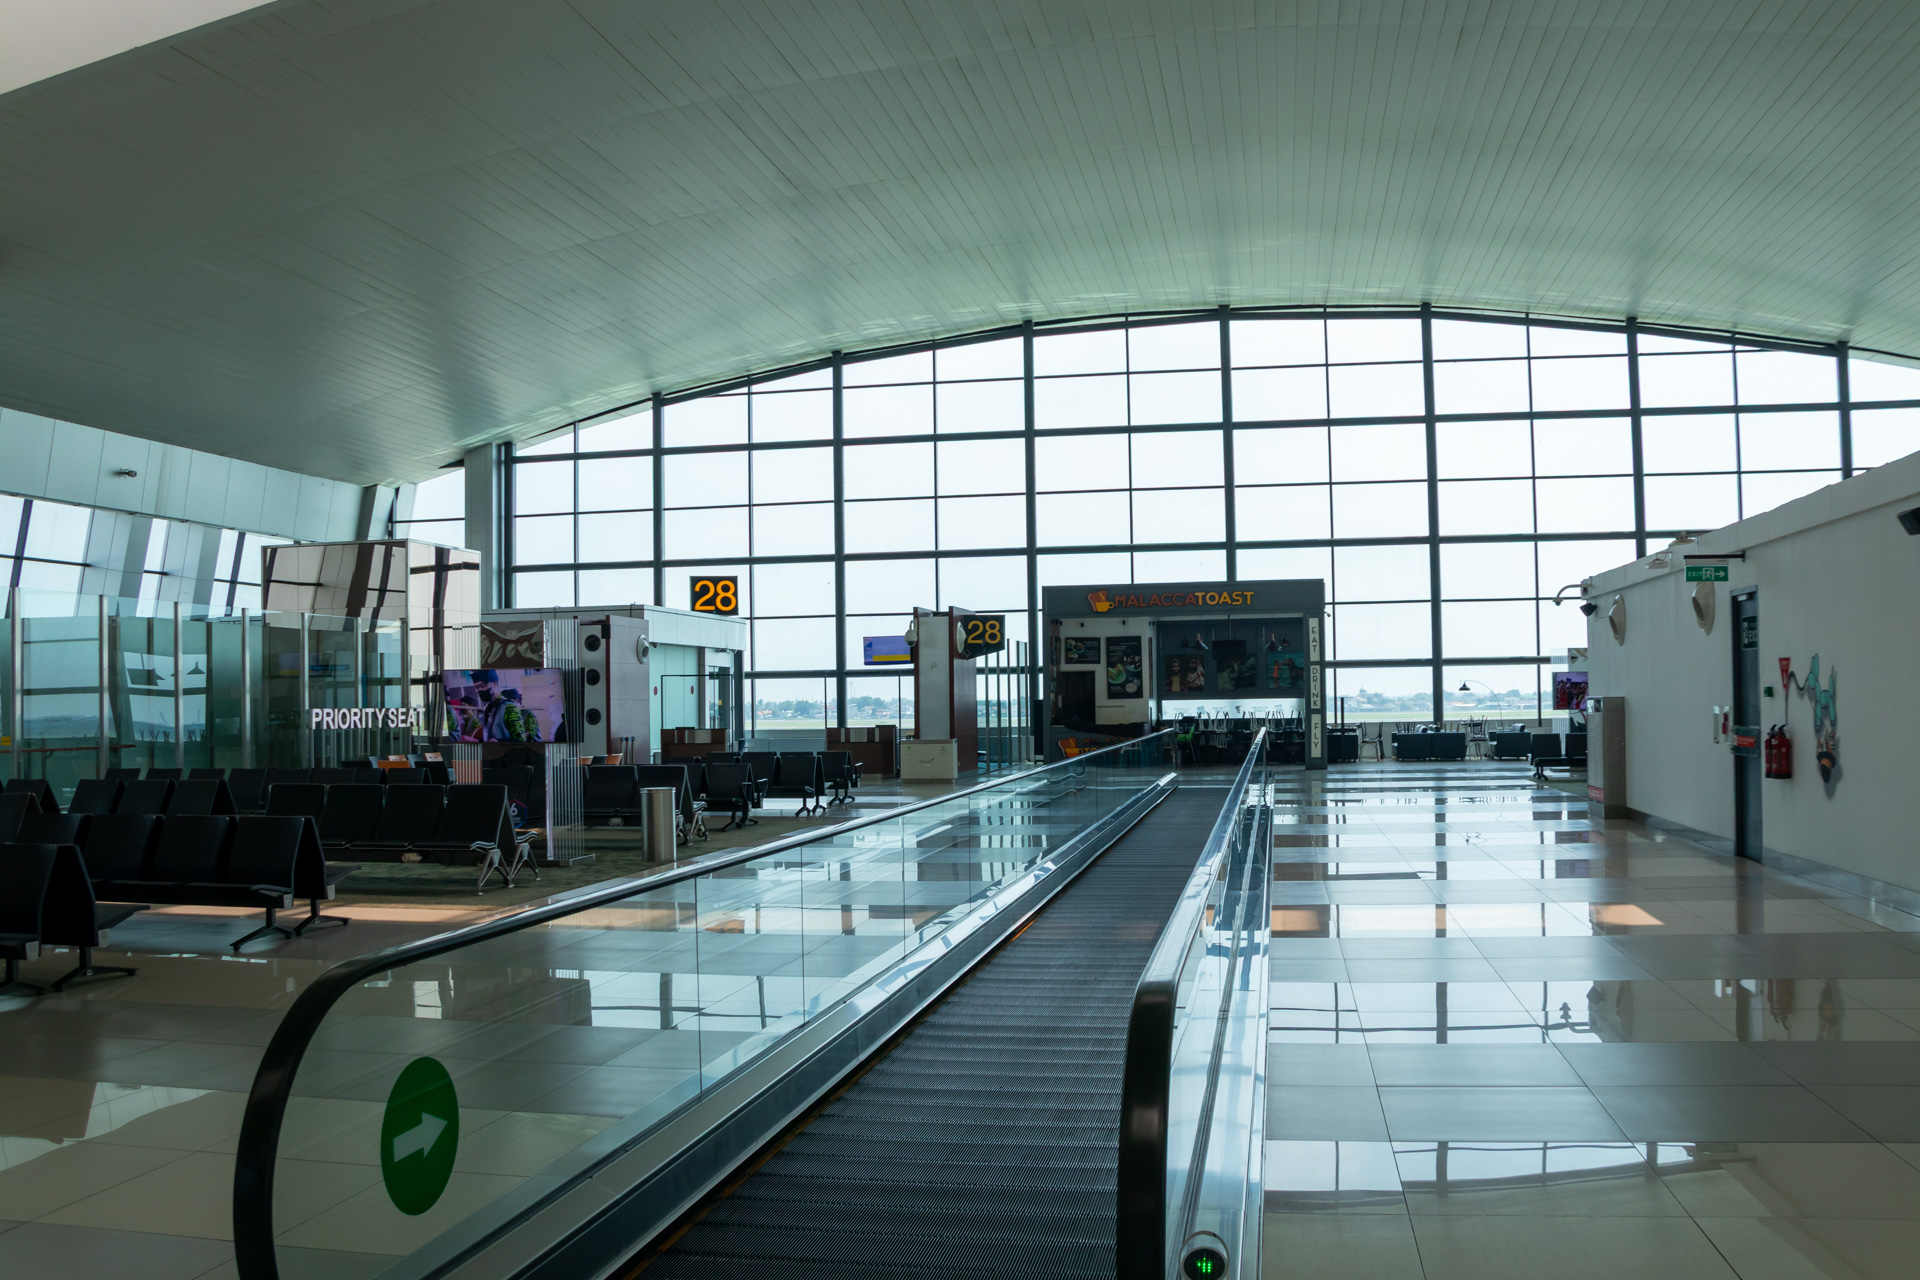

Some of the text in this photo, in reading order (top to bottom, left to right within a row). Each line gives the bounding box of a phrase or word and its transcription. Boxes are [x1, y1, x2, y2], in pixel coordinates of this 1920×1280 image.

[694, 579, 737, 612] 28
[967, 620, 1001, 645] 28
[1311, 626, 1319, 653] EAT
[1312, 667, 1320, 708] DRINK
[312, 707, 426, 730] PRIORITY SEAT
[1313, 722, 1321, 749] FLY
